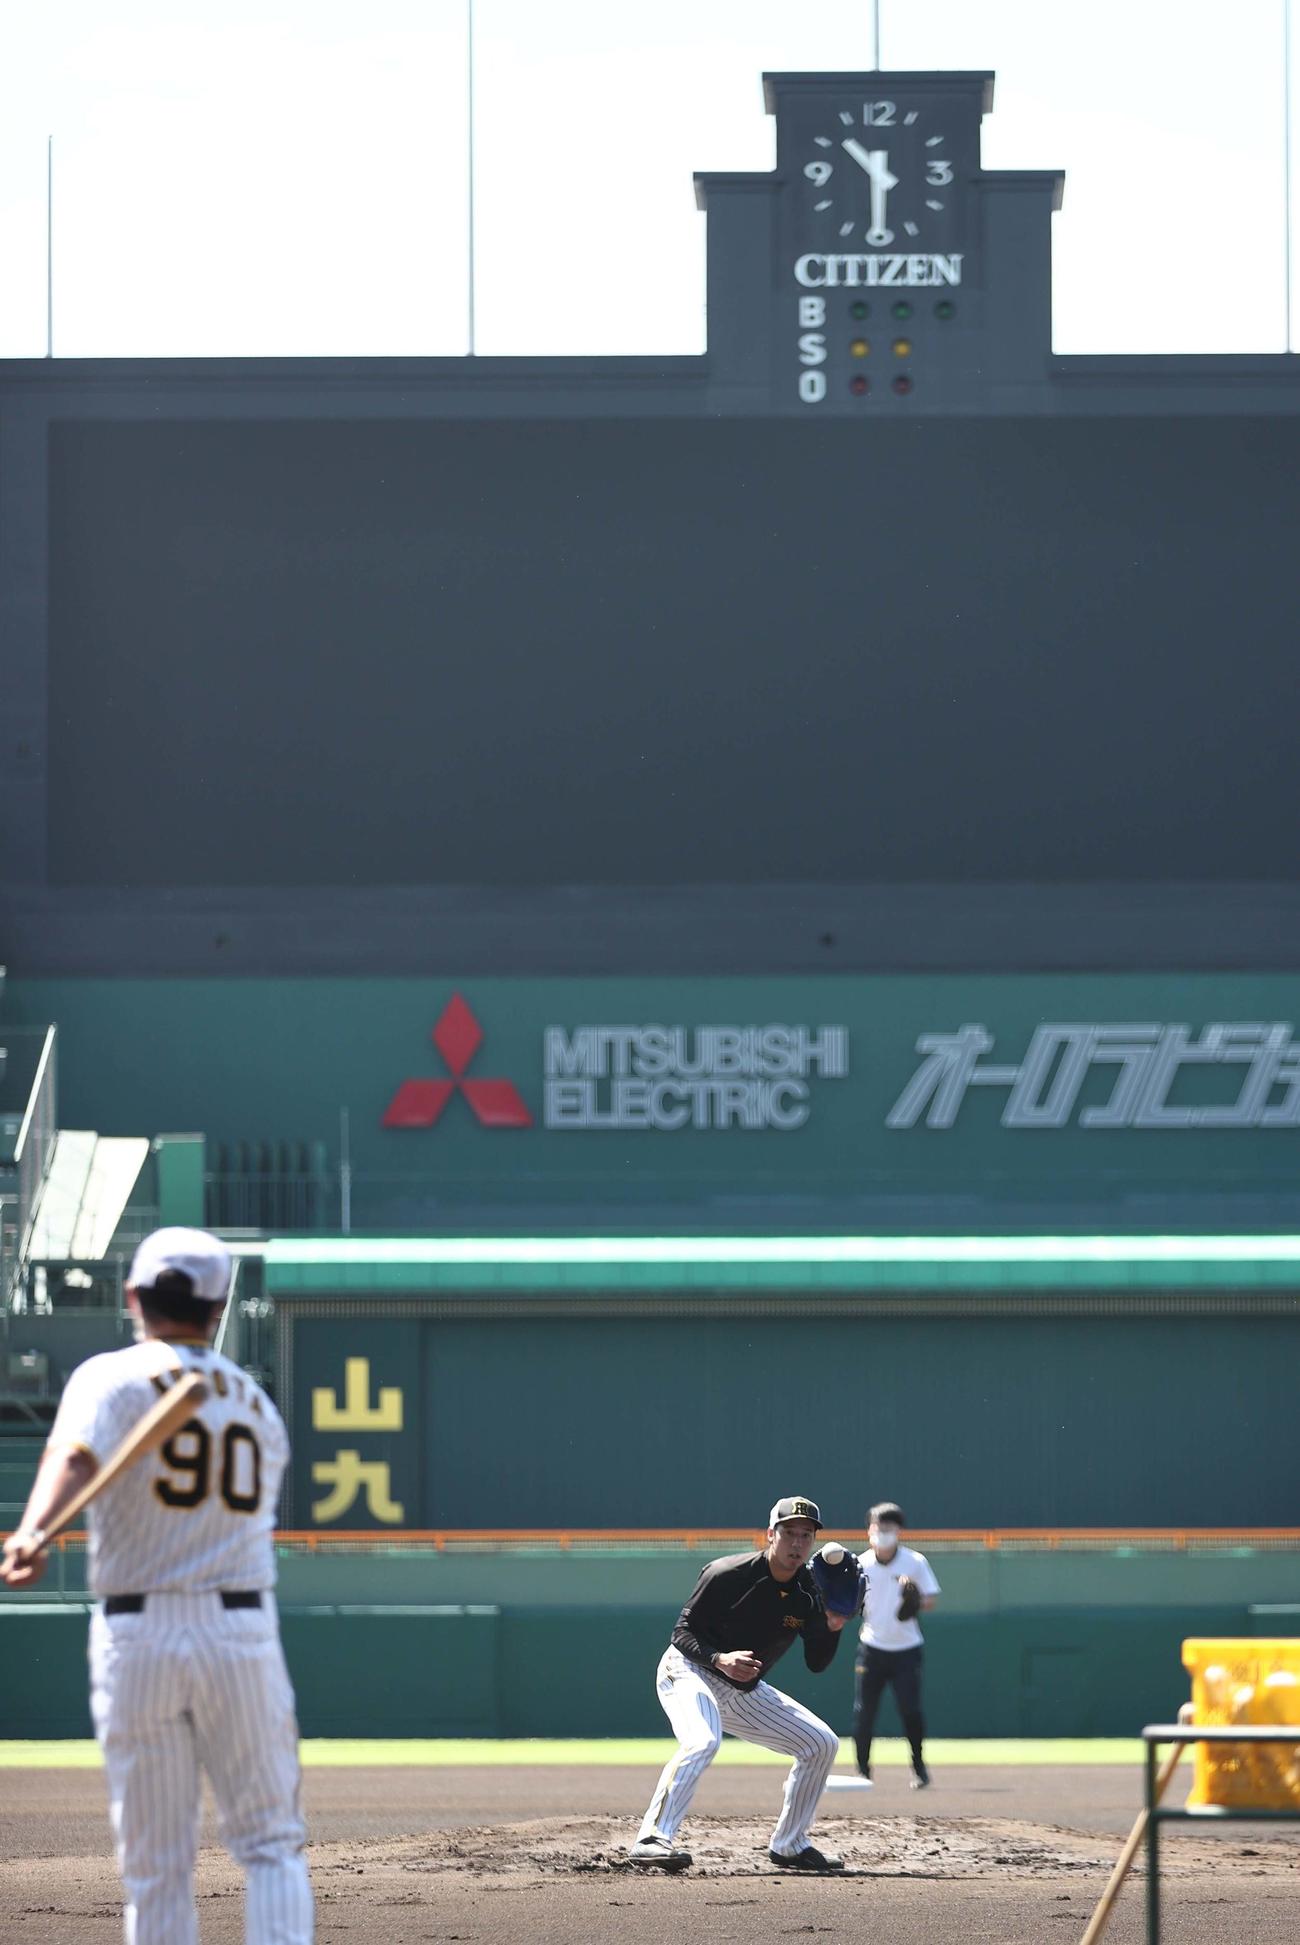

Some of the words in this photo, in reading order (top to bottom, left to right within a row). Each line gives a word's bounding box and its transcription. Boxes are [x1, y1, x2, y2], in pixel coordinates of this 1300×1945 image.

[863, 101, 896, 127] 12
[803, 160, 833, 187] 9
[925, 160, 954, 186] 3
[794, 253, 963, 287] CITIZEN
[799, 296, 826, 328] B
[798, 333, 827, 366] S
[799, 370, 827, 403] O
[544, 1025, 848, 1078] MITSUBISHI
[544, 1078, 810, 1130] ELECTRIC
[312, 1357, 403, 1522] 山九
[153, 1418, 263, 1514] 90
